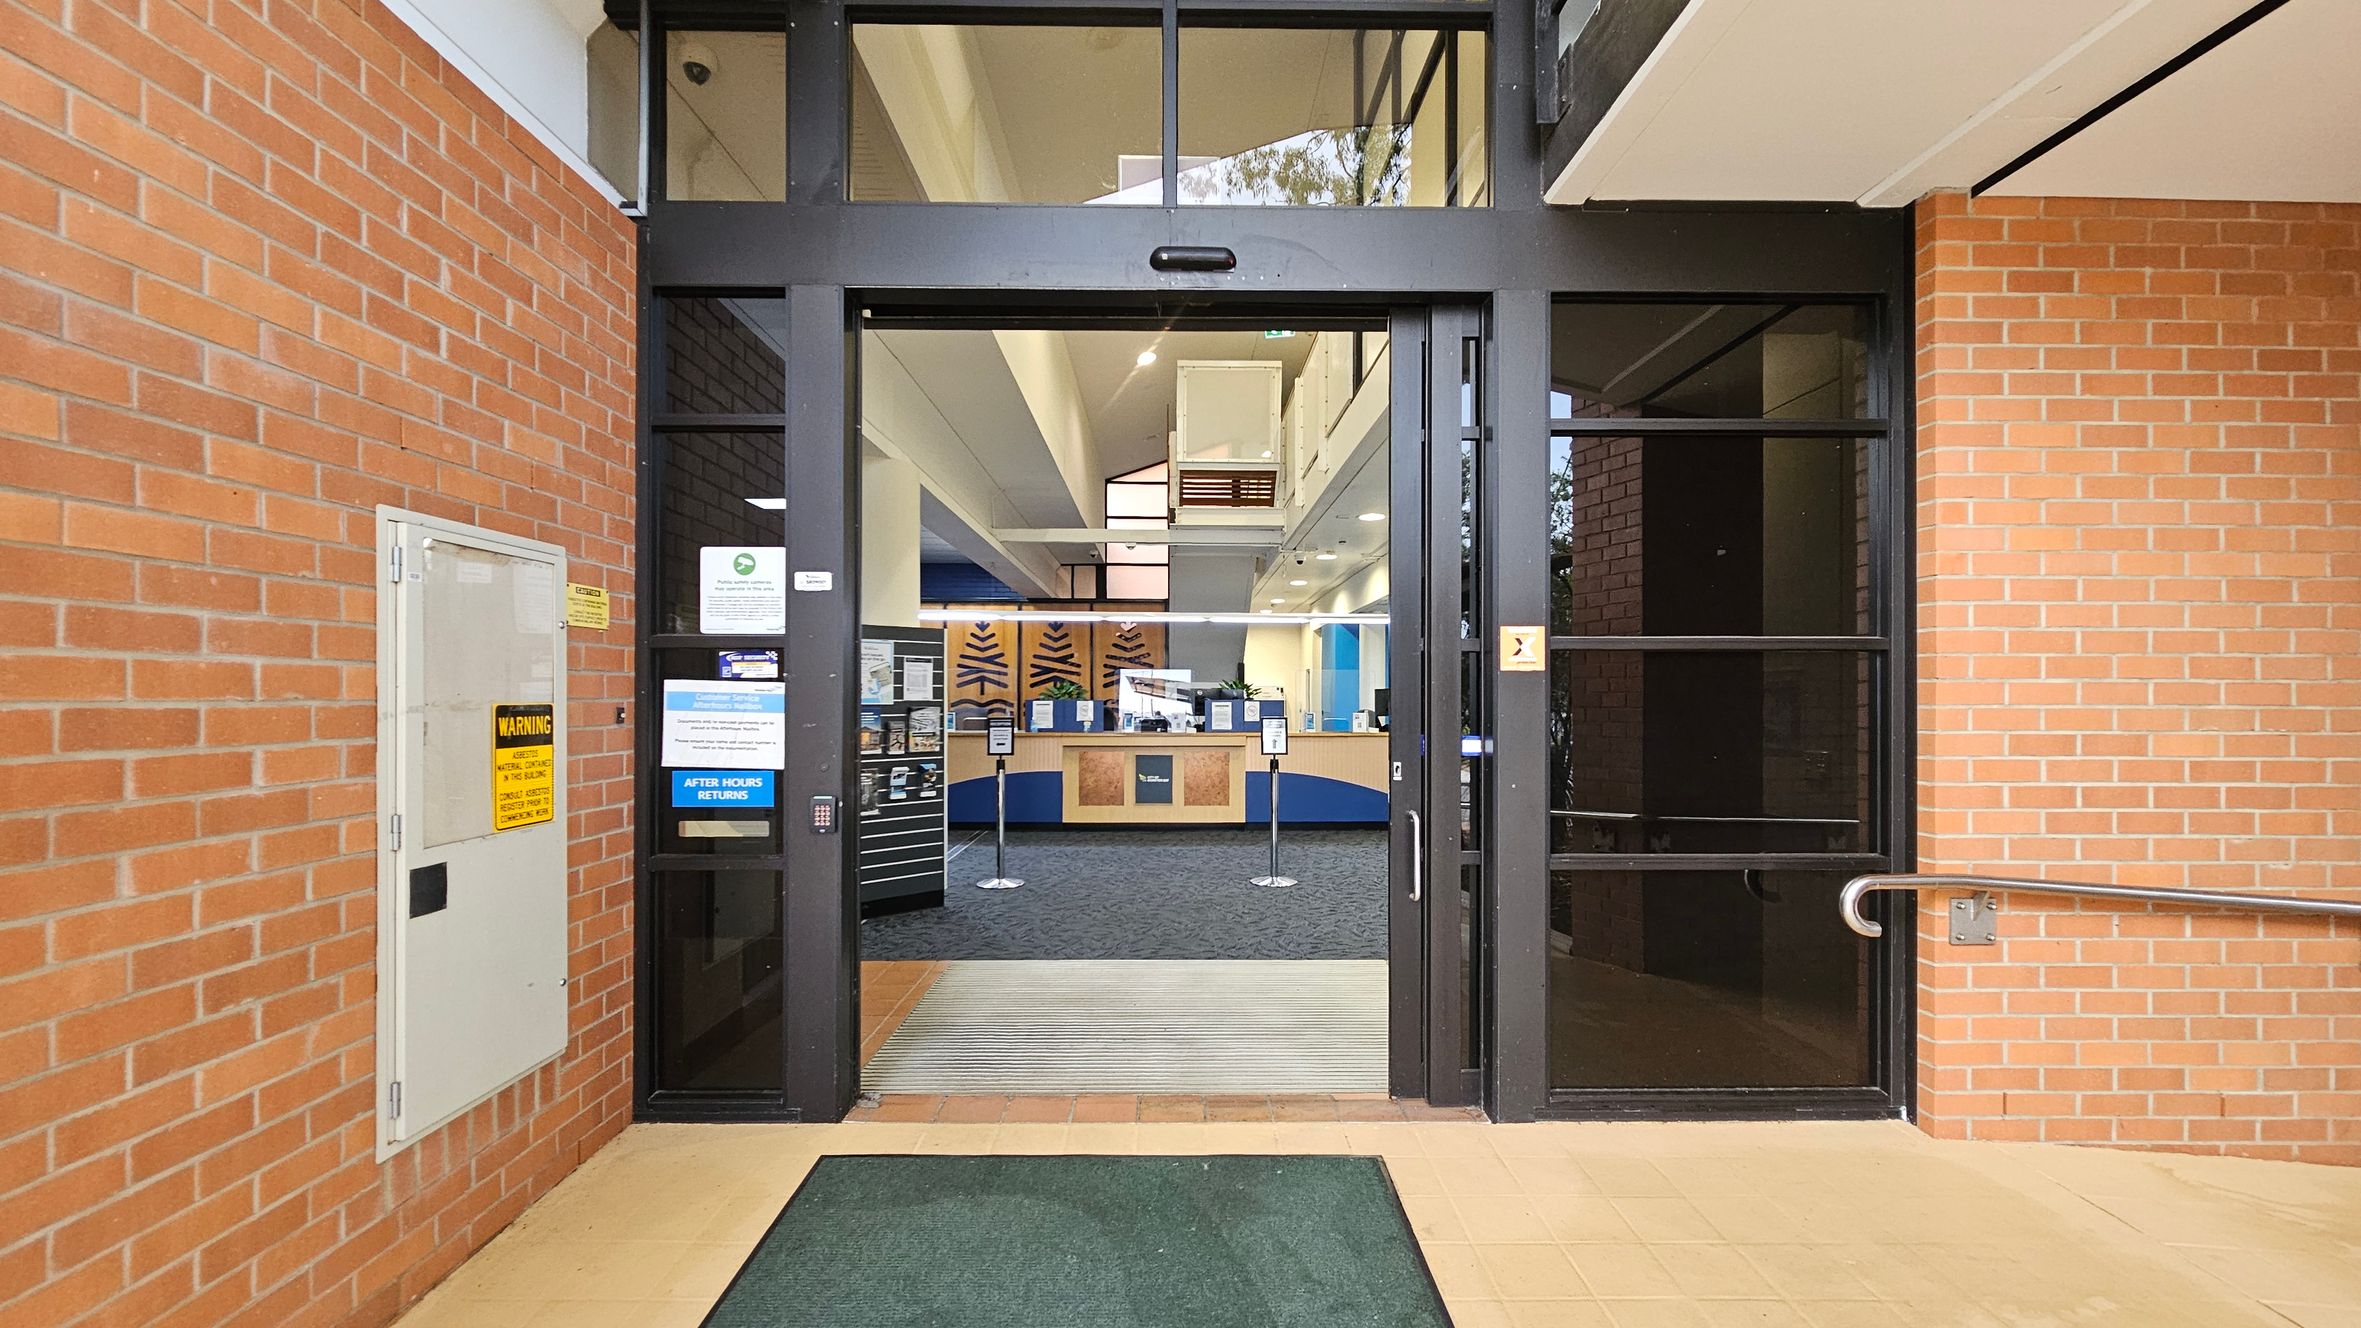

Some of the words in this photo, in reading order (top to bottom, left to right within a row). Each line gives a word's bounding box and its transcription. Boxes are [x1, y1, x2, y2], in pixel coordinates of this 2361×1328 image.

[576, 587, 600, 596] CAUTION
[695, 693, 731, 701] Customer
[731, 694, 760, 702] Service
[498, 715, 551, 736] WARNING
[512, 750, 538, 759] ASBESTOS
[497, 762, 522, 772] MATERIAL
[525, 759, 551, 770] CONTAINED
[511, 773, 522, 781] THIS
[524, 770, 546, 780] BUILDING
[684, 778, 719, 787] AFTER
[722, 778, 763, 787] HOURS
[499, 790, 523, 801] CONSULT
[525, 787, 550, 797] ASBESTOS
[697, 791, 748, 800] RETURNS
[500, 801, 524, 812] REGISTER
[527, 799, 541, 808] PRIOR
[543, 797, 549, 805] TO
[500, 811, 534, 823] COMMENCING
[536, 808, 549, 817] WORK
